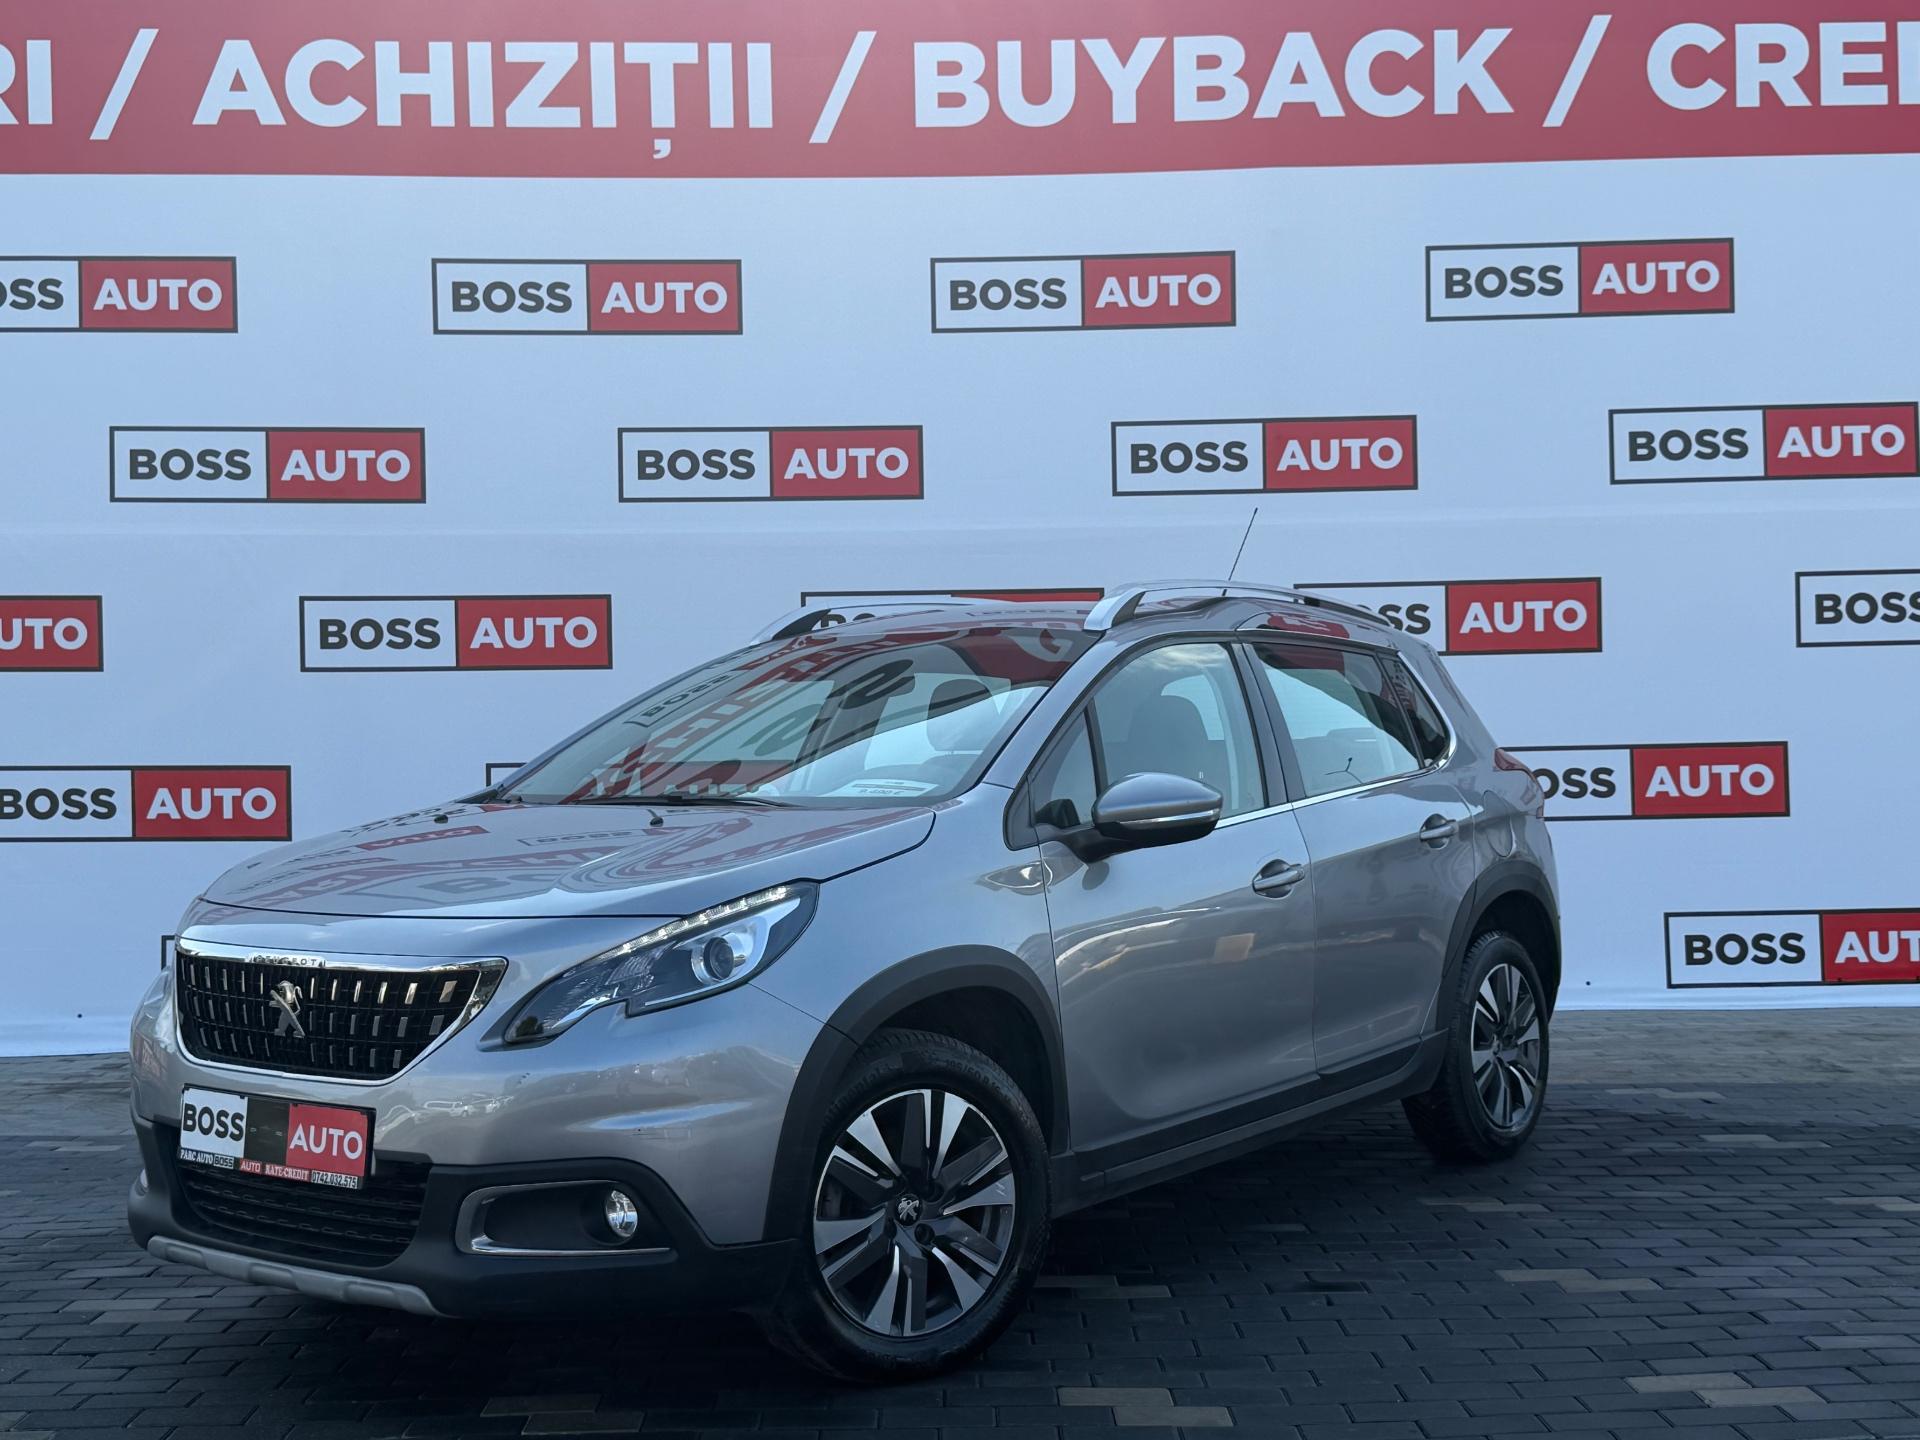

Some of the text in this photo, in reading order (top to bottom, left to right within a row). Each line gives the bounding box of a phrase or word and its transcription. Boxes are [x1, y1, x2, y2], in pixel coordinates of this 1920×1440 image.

[0, 40, 52, 124] I
[193, 39, 772, 158] ACHIZIȚII
[914, 29, 1513, 127] BUYBACK
[1647, 22, 1920, 110] CRE
[0, 278, 222, 310] SS AUTO
[950, 274, 1221, 310] BOSS AUTO
[1445, 261, 1719, 298] BOSS AUTO
[452, 281, 727, 313] BOSS AUTO
[1131, 438, 1402, 473] BOSS AUTO
[1629, 424, 1905, 461] BOSS AUTO
[130, 449, 410, 481] BOSS AUTO
[638, 447, 908, 480] BOSS AUTO
[320, 617, 597, 650] BOSS AUTO
[1358, 600, 1587, 635] SS AUTO
[1531, 764, 1774, 799] OSS AUTO
[0, 788, 276, 820] BOSS AUTO
[1685, 933, 1805, 965] BOSS
[183, 1103, 363, 1160] BOSS AUTO
[180, 1149, 197, 1160] PARC
[197, 1152, 214, 1165] AUTO
[214, 1155, 233, 1168] BOSS
[241, 1160, 260, 1172] AUTO
